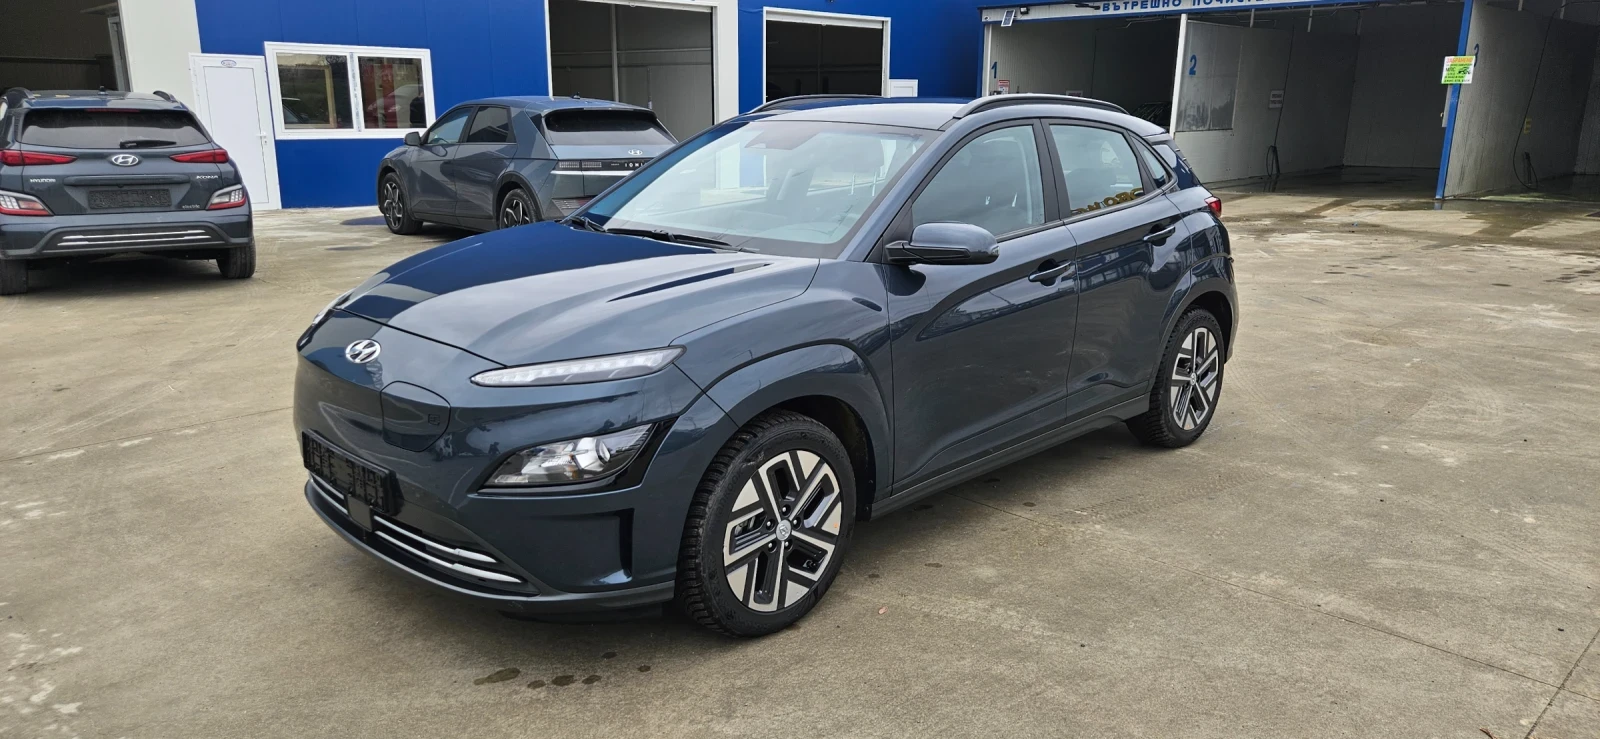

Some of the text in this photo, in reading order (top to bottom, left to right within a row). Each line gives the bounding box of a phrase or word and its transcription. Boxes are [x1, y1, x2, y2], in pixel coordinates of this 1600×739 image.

[1102, 0, 1182, 12] ВЪТРЕШНО
[991, 61, 998, 79] 1
[1188, 54, 1197, 76] 2
